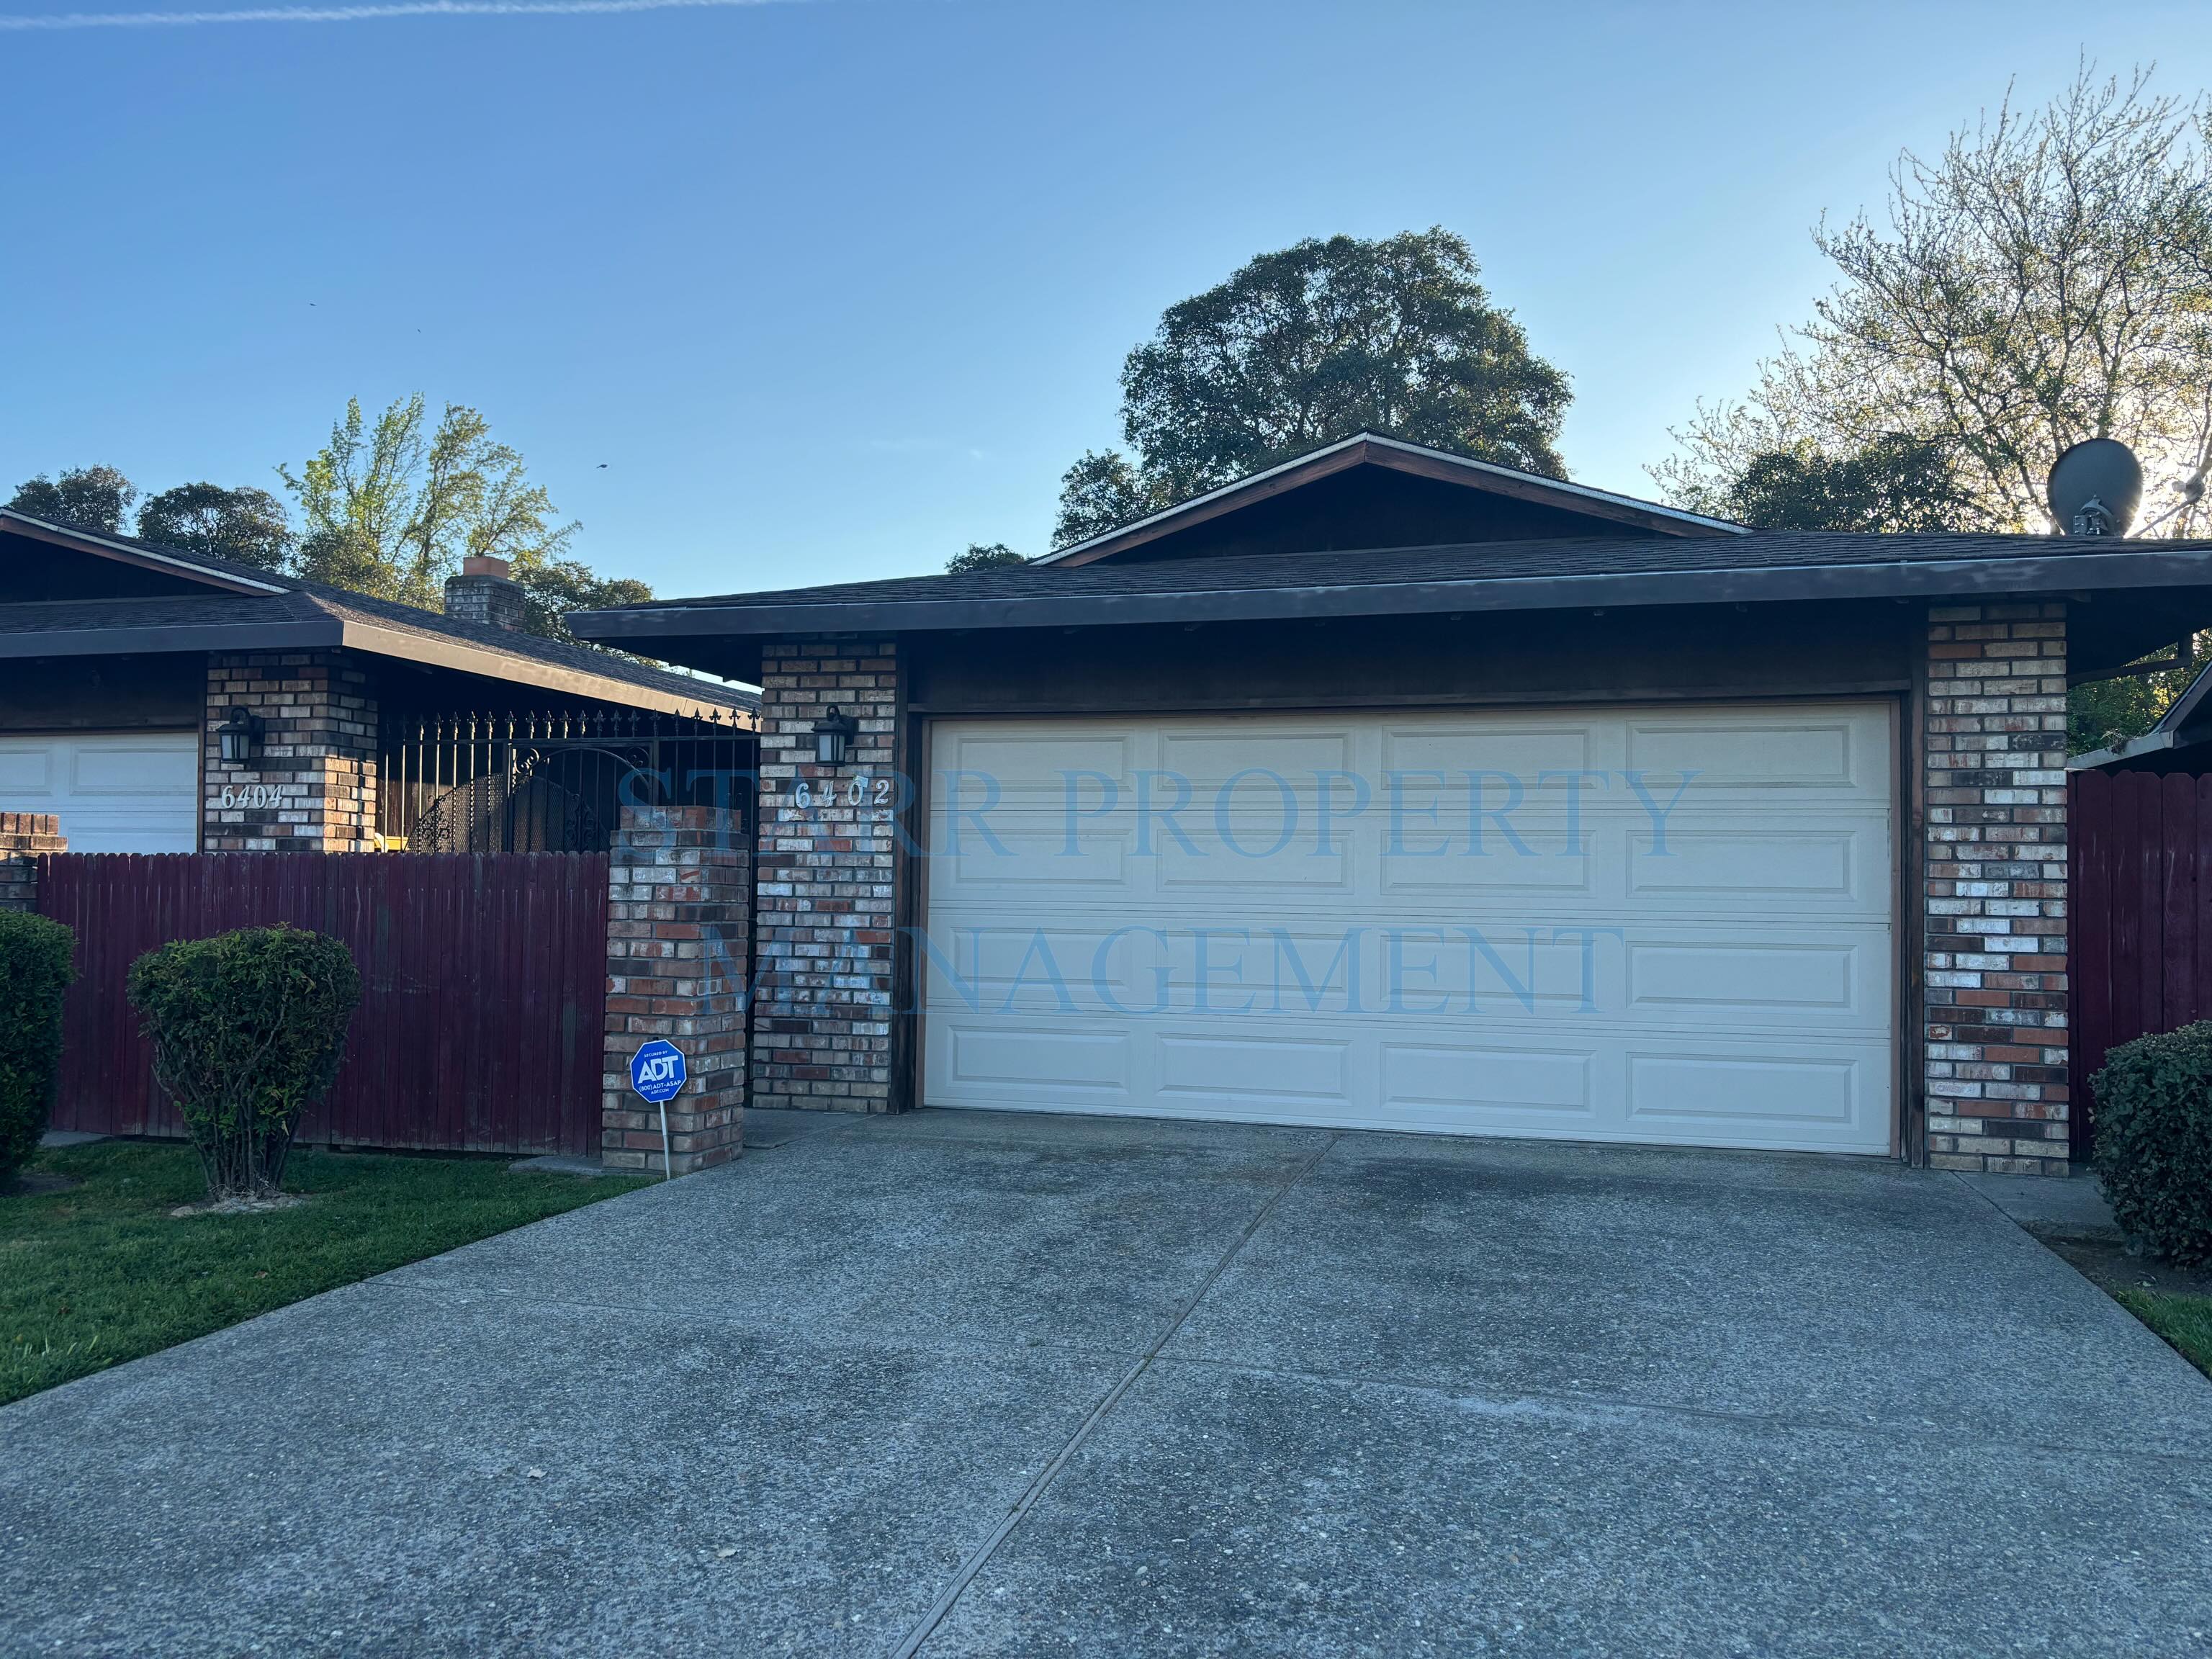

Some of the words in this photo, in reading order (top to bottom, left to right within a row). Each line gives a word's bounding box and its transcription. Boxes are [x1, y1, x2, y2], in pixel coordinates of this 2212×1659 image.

[221, 785, 284, 809] 6404
[795, 779, 890, 809] 6402
[637, 1055, 679, 1084] ADT
